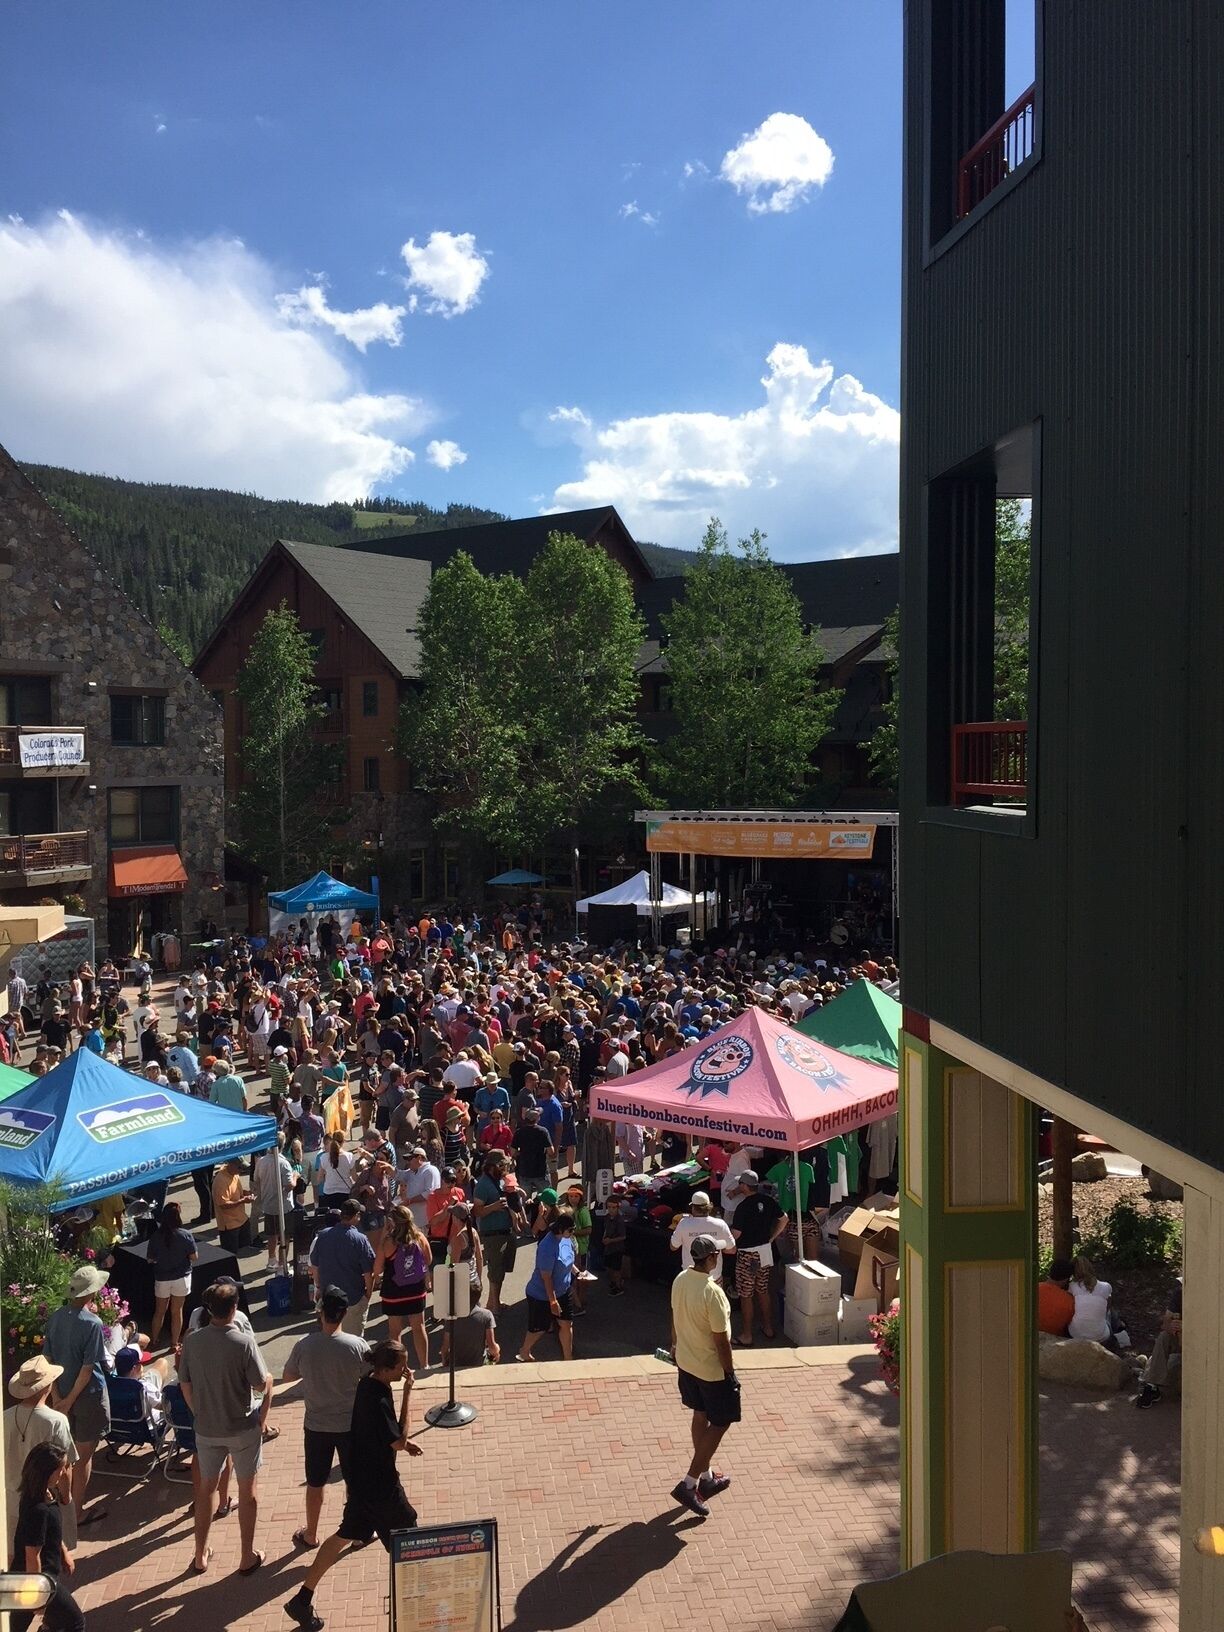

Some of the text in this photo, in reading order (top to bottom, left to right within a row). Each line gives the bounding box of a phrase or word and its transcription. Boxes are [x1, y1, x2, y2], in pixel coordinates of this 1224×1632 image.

[60, 738, 74, 748] Pork
[728, 1036, 751, 1057] RIBBON
[701, 1063, 747, 1081] FESTIVAL
[95, 1109, 177, 1139] Farmland
[596, 1098, 788, 1142] blueribbonbaconfestival.com
[811, 1105, 863, 1135] OHHHH,
[69, 1131, 258, 1195] PASSION FOR PORK SINCE 1959
[401, 1539, 415, 1547] BLUE
